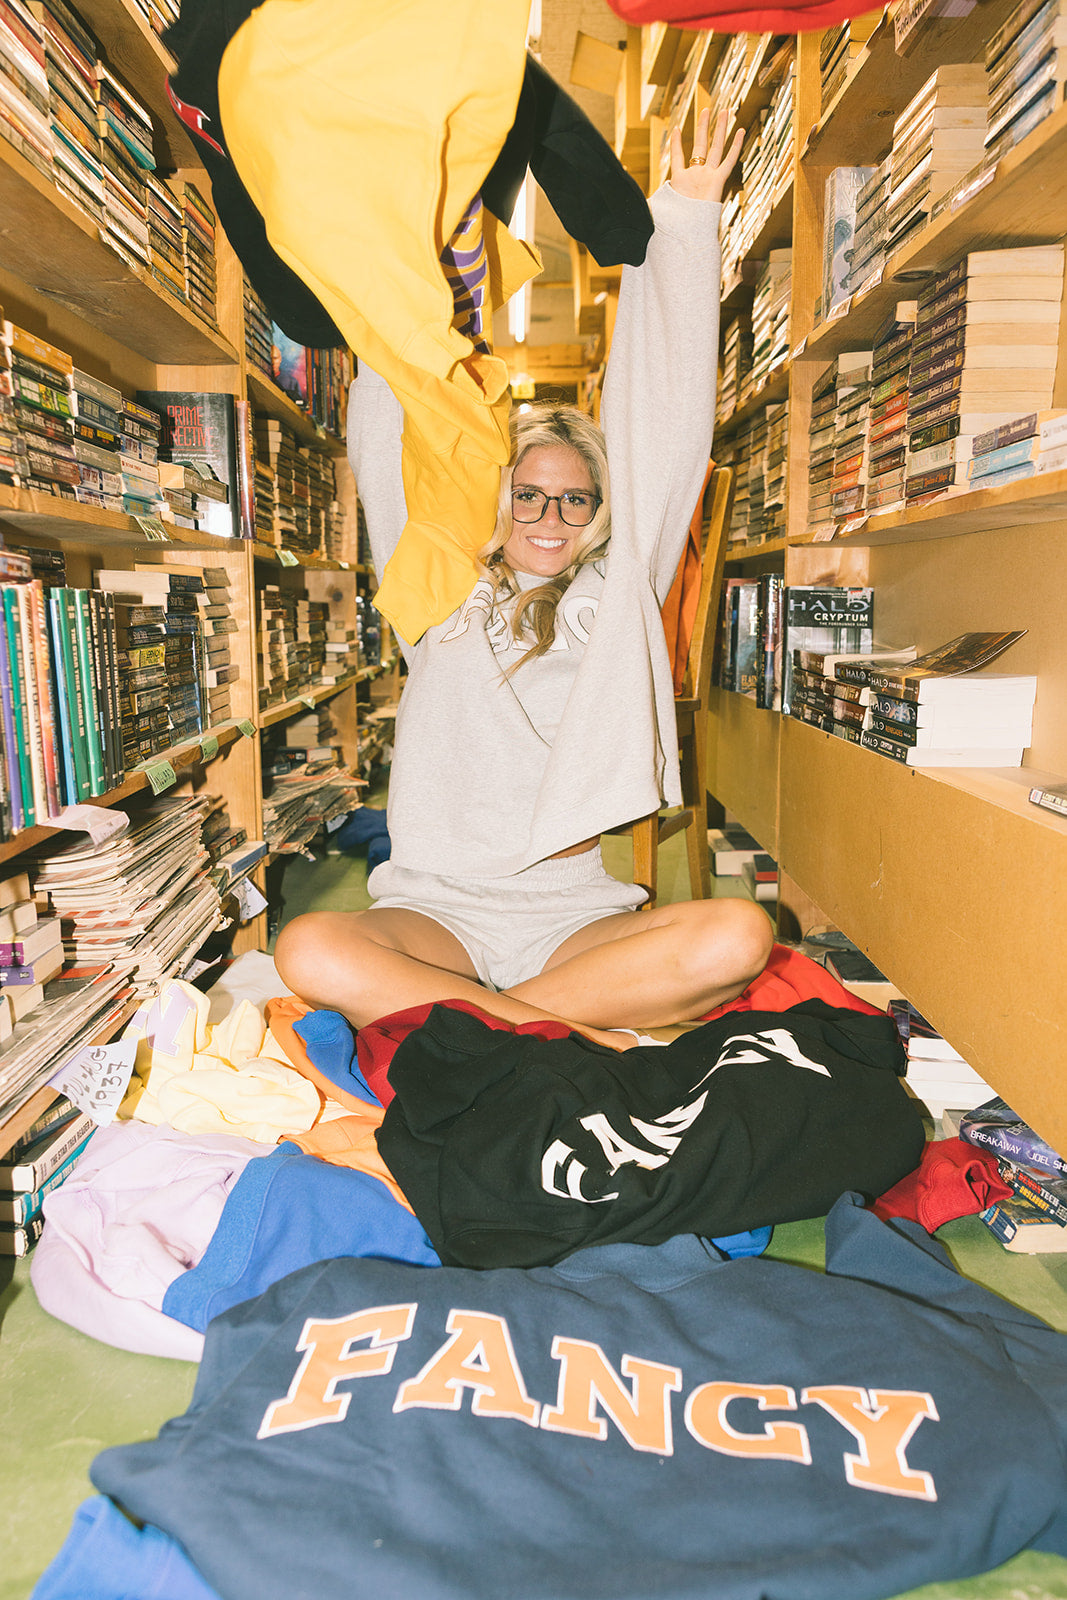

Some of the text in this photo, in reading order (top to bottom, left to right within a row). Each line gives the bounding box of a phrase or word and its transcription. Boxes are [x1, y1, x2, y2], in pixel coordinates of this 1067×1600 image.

[167, 405, 203, 427] PRIME
[160, 426, 214, 447] DIRECTIVE
[789, 599, 870, 612] HALO
[814, 612, 868, 622] CRYPTUM
[845, 669, 867, 681] HALO
[872, 676, 889, 689] HALO
[58, 1144, 68, 1161] STAR
[970, 1129, 1022, 1155] BREAKAWAY
[1026, 1152, 1050, 1167] JOEL
[256, 1302, 940, 1502] FANCY
